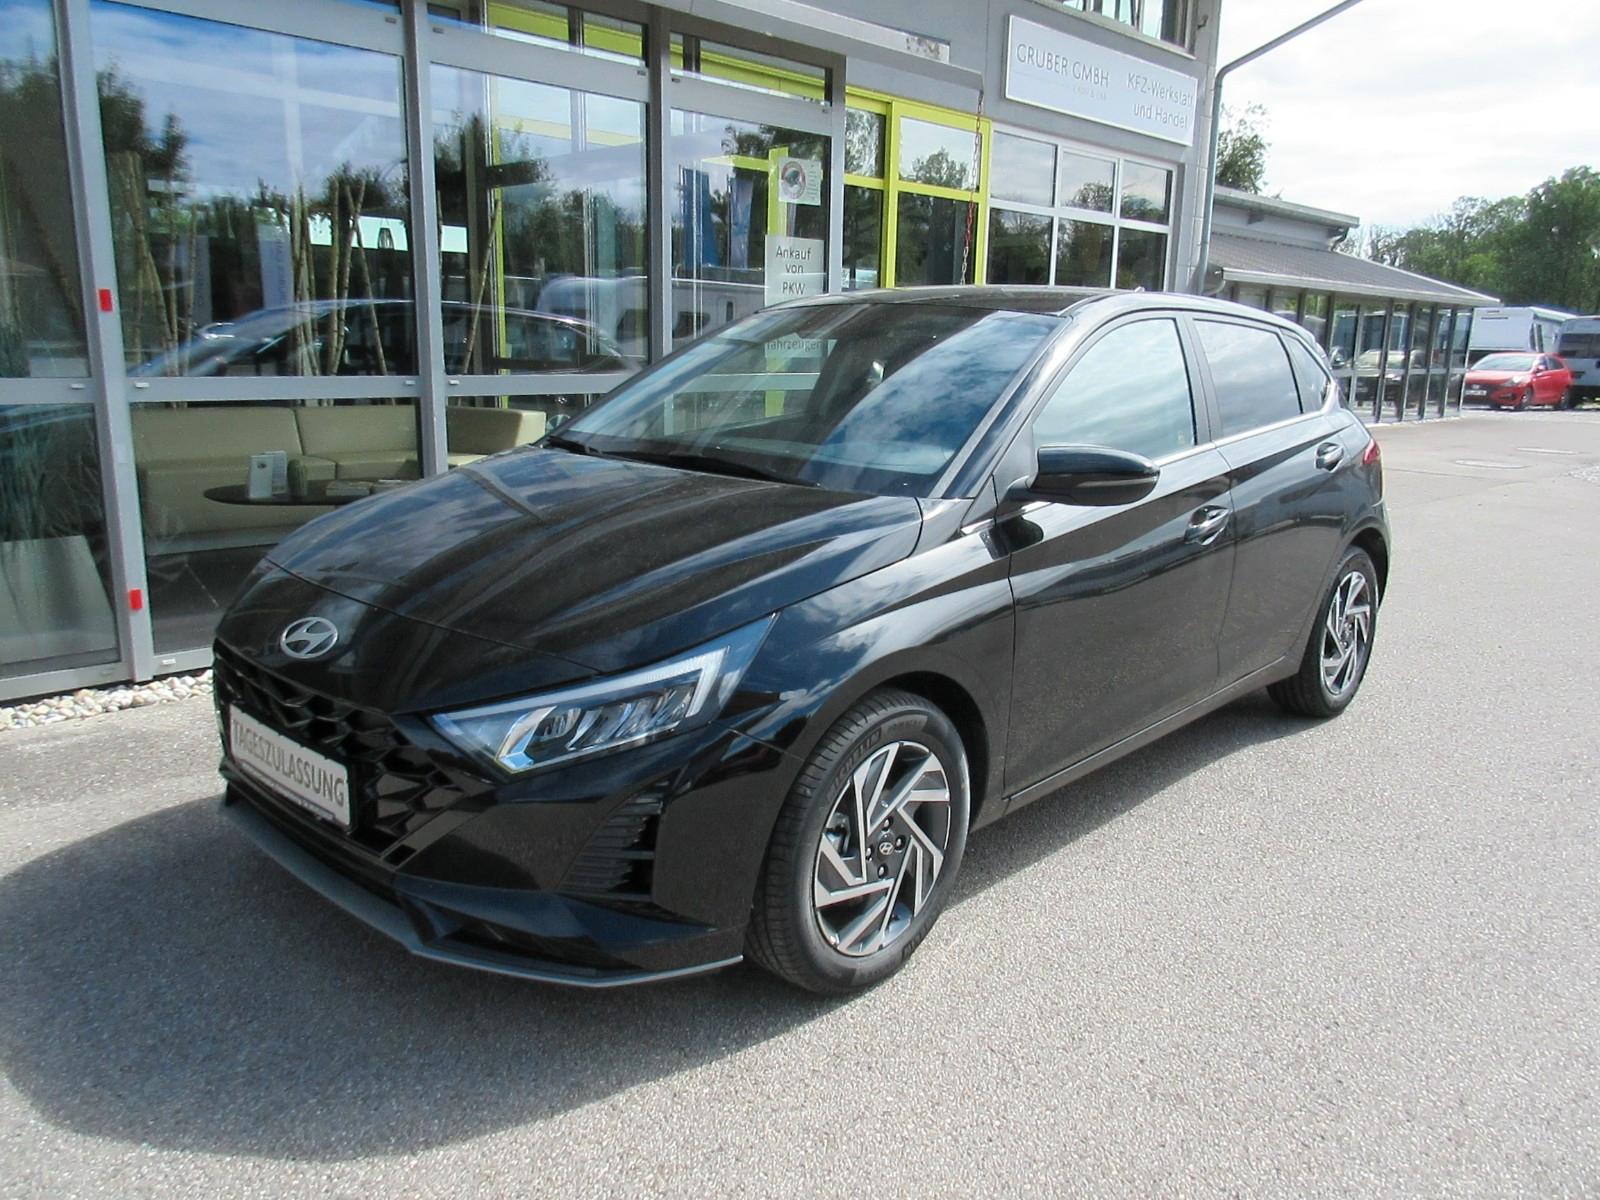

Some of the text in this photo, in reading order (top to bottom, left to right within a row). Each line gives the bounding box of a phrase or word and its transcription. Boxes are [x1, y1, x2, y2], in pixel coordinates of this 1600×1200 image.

[1016, 43, 1109, 89] GRUBER GMBH
[1134, 103, 1189, 130] und Handel
[775, 246, 811, 261] Ankauf
[785, 263, 804, 274] von
[782, 281, 805, 296] PKW
[232, 720, 344, 807] TAGESZULASSUNG
